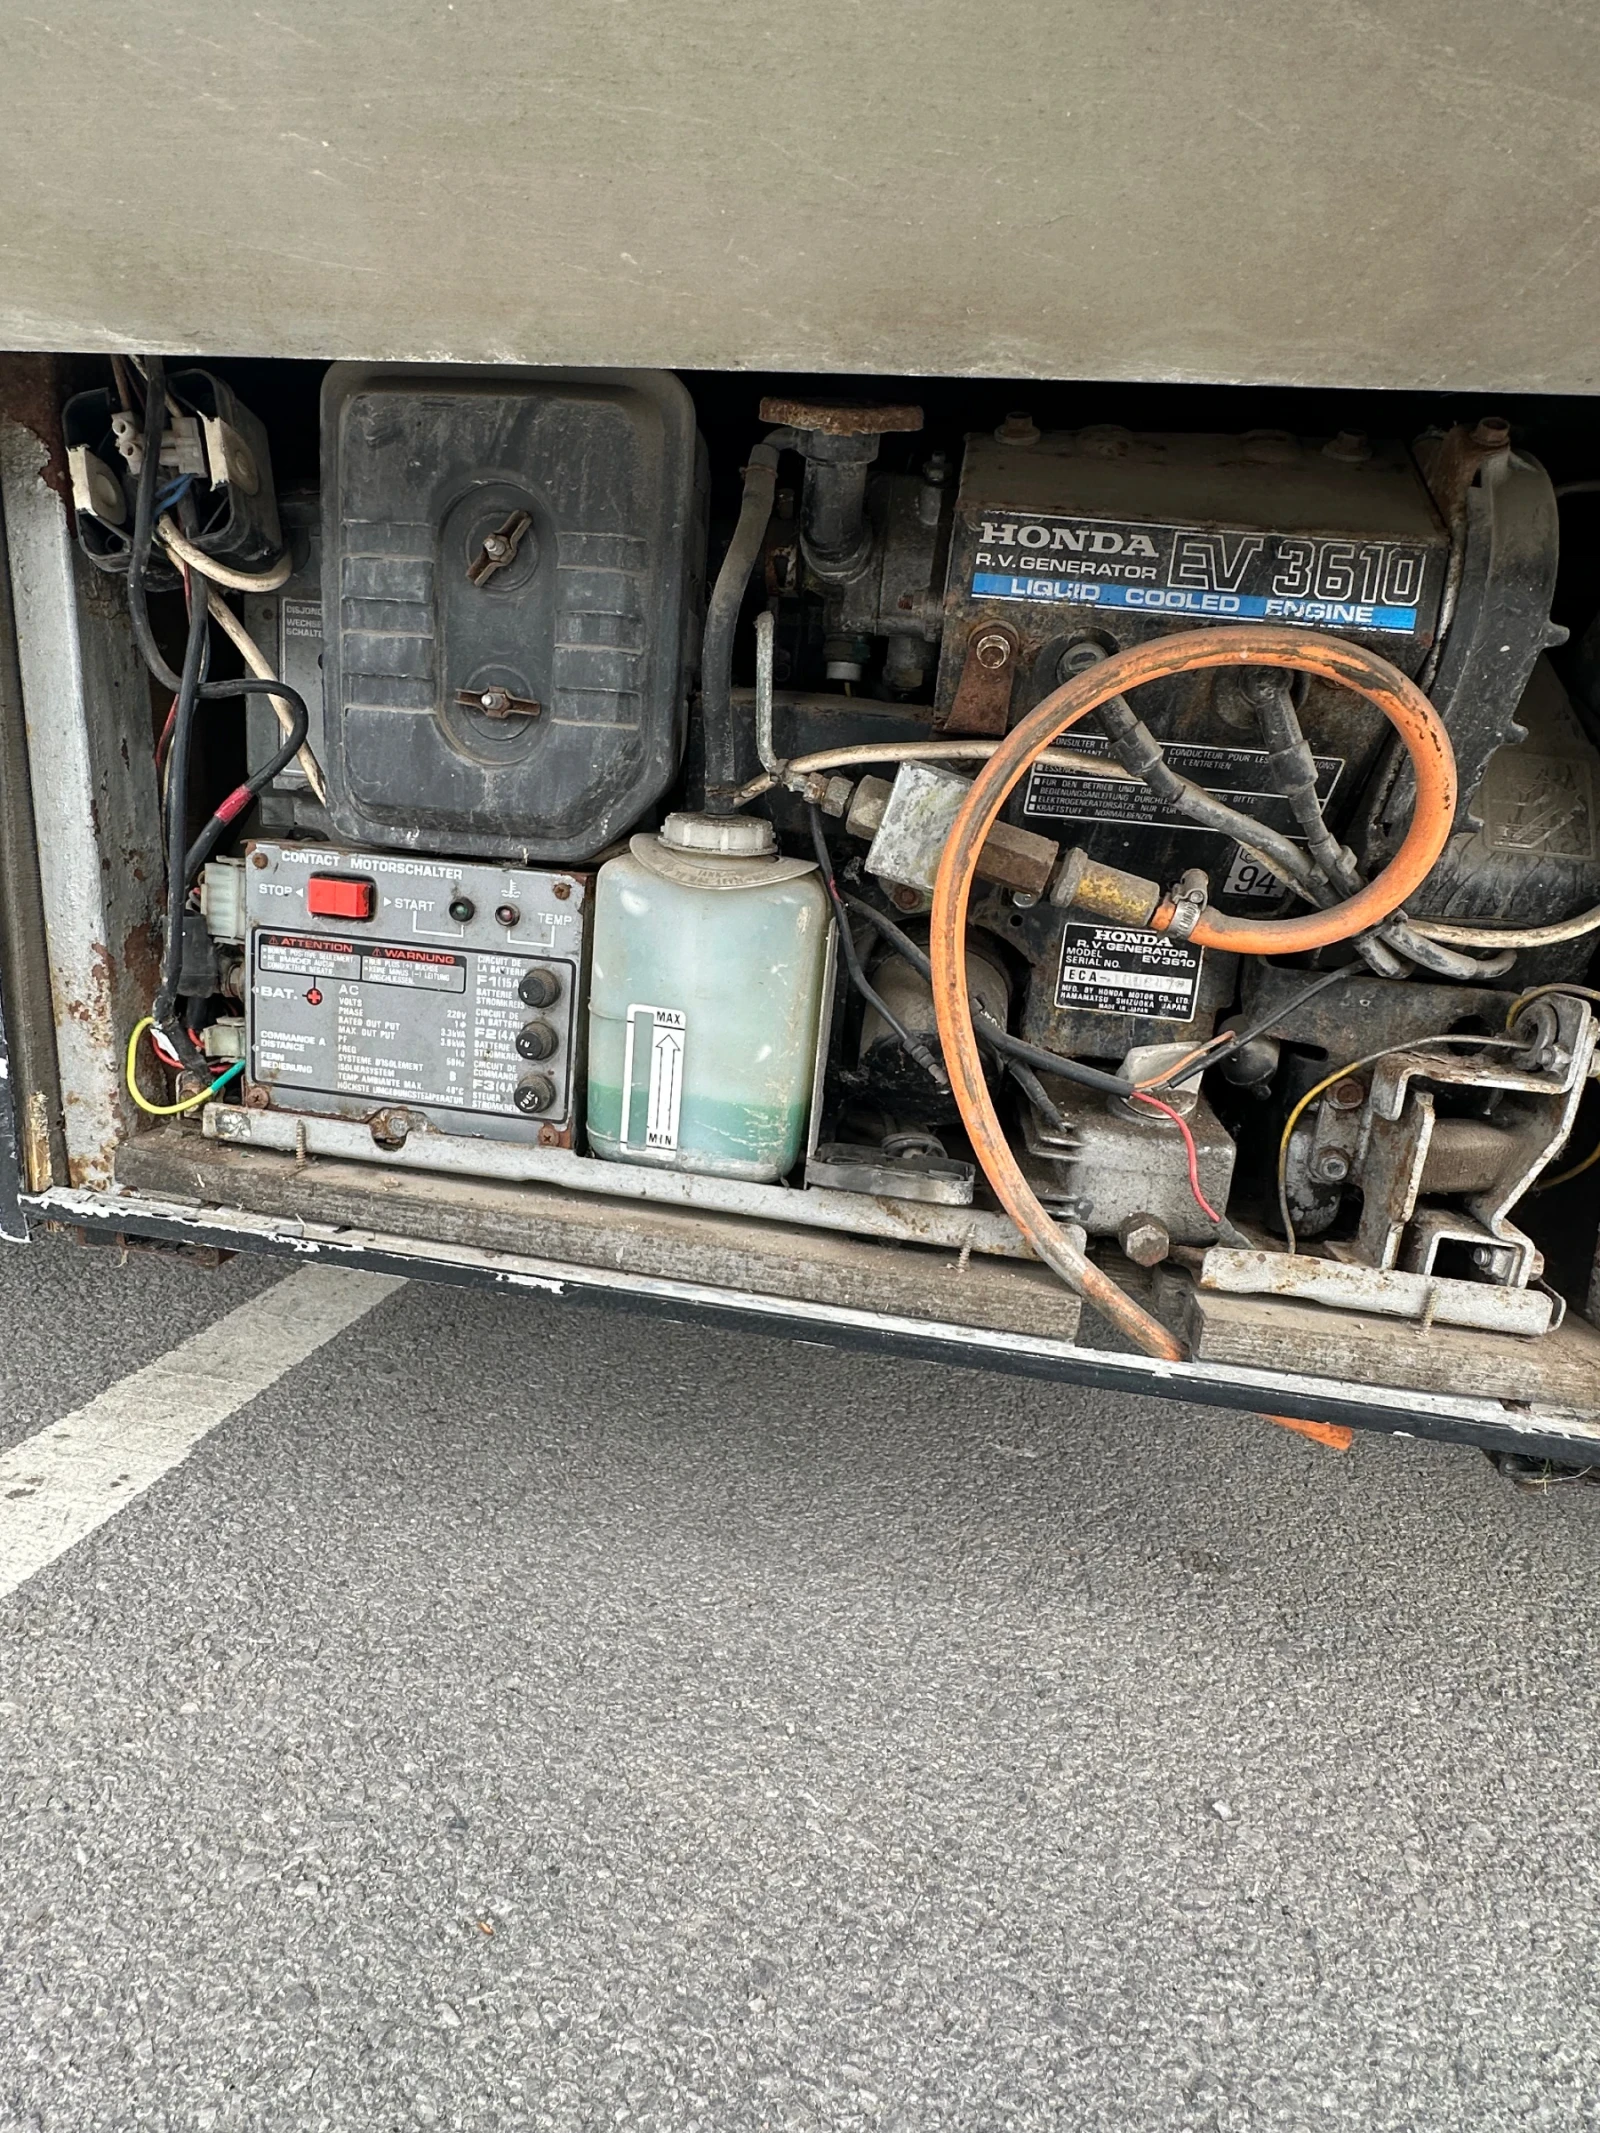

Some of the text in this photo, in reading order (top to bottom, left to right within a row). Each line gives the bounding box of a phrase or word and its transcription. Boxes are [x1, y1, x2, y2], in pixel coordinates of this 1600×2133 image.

[979, 521, 1426, 606] HONDA EV 3610
[1011, 578, 1374, 623] LIQUID COOLED ENGINE
[1167, 757, 1178, 765] ET
[1170, 748, 1224, 760] CONDUCTEUR
[1228, 753, 1250, 762] POUR
[1062, 780, 1078, 788] DEN
[1082, 782, 1113, 791] BETRIEB
[1119, 785, 1135, 793] UND
[1141, 804, 1157, 812] NUR
[282, 851, 462, 880] CONTACT MOTORSCHALTER
[1234, 865, 1278, 895] 94
[259, 884, 292, 896] STOP
[394, 898, 435, 911] START
[538, 912, 572, 926] TEMP
[281, 938, 353, 952] ATTENTION
[1094, 929, 1173, 948] HONDA
[384, 949, 455, 964] WARNUNG
[1066, 947, 1103, 959] MODEL
[478, 955, 522, 967] CIRCUIT DE
[1065, 956, 1121, 969] SERIAL NO.
[477, 964, 487, 972] LA
[261, 986, 298, 1000] BAT.
[338, 984, 359, 995] AC
[476, 988, 512, 999] BATTERIE
[1062, 984, 1079, 993] MFD.
[1084, 986, 1094, 994] BY
[1098, 988, 1123, 997] HONDA
[1128, 991, 1154, 1000] MOTOR
[1175, 997, 1190, 1005] LTD.
[476, 996, 525, 1009] STROMKREIS
[1060, 991, 1109, 1003] HAMAMATSU
[1116, 997, 1154, 1008] SHIZUOKA
[338, 1007, 364, 1017] PHASE
[339, 997, 467, 1020] VOLTS 220V
[475, 1008, 519, 1020] CIRCUIT DE
[1127, 1006, 1149, 1014] JAPAN
[338, 1016, 363, 1026] RATED
[366, 1019, 381, 1028] OUT
[385, 1021, 400, 1031] PUT
[475, 1017, 485, 1025] LA
[260, 1030, 316, 1045] COMMANDE
[338, 1035, 347, 1043] PF
[361, 1029, 377, 1038] OUT
[380, 1030, 396, 1040] PUT
[261, 1039, 305, 1052] DISTANCE
[474, 1040, 510, 1051] BATTERIE
[261, 1051, 284, 1061] FERN
[474, 1049, 523, 1061] STROMKREIS
[261, 1059, 313, 1074] BEDIENUNG
[338, 1063, 395, 1078] ISOLIERSYSTEM
[473, 1060, 516, 1072] CIRCUIT DE
[473, 1069, 518, 1081] COMMANDE
[361, 1075, 401, 1088] AMBIANTE
[404, 1081, 424, 1090] MAX.
[373, 1086, 464, 1105] UMGEBUNGSTEMPERATUR
[472, 1091, 501, 1101] STEUER
